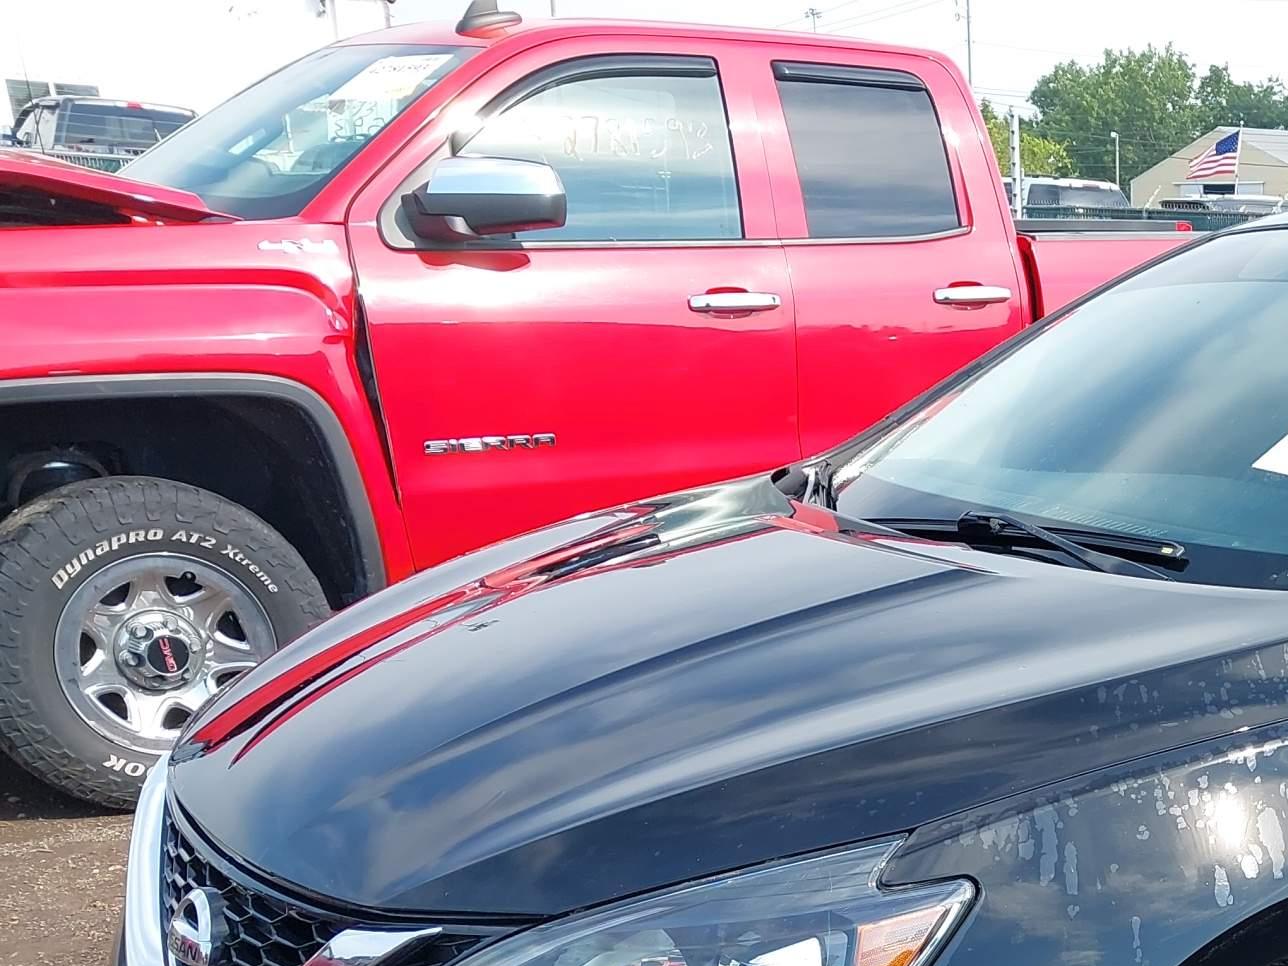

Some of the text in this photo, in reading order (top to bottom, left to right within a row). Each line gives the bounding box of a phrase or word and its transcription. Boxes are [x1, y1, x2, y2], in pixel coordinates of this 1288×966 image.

[423, 432, 557, 455] SIERRA
[171, 529, 217, 549] AT2
[220, 544, 279, 593] Xtreme
